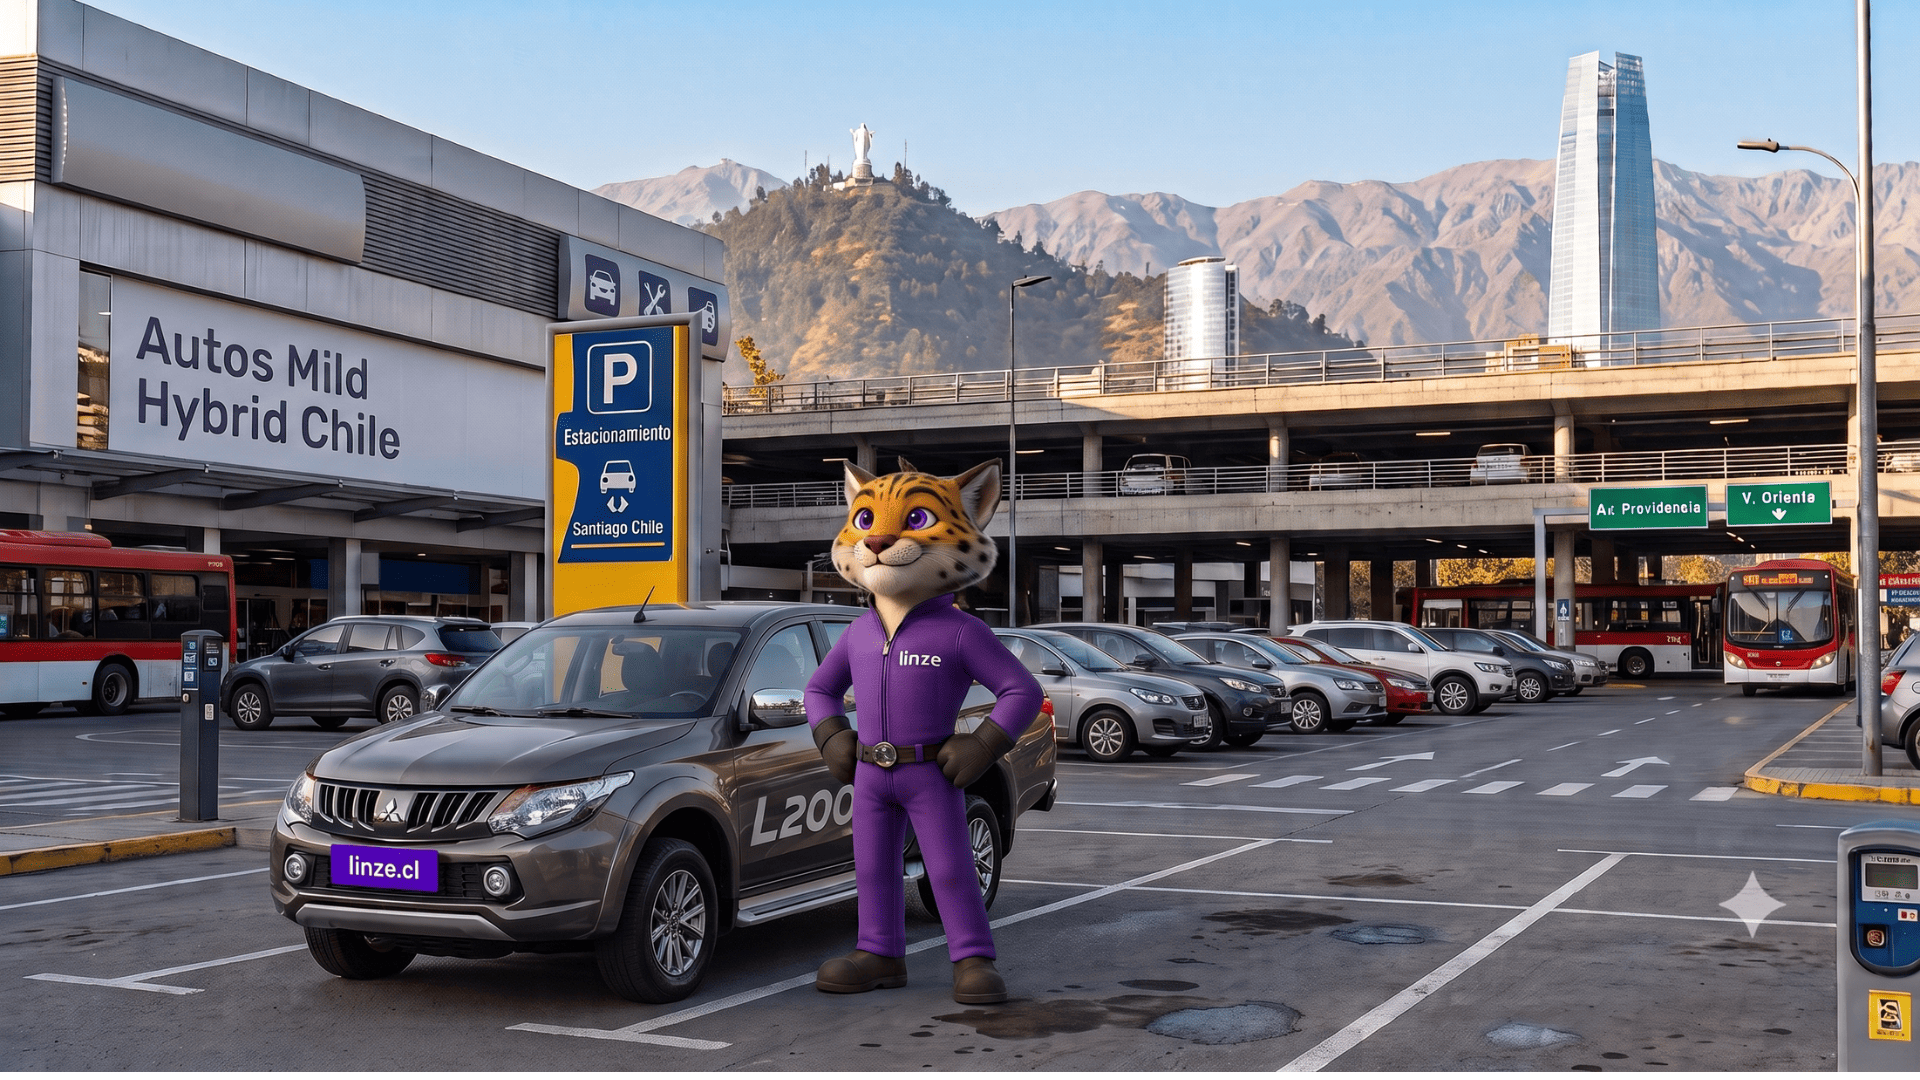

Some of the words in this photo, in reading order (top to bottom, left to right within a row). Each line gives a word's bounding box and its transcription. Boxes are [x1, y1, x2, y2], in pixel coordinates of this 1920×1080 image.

[136, 316, 274, 382] Autos
[288, 344, 368, 400] Mild
[603, 353, 638, 404] P
[138, 377, 287, 441] Hybrid
[302, 405, 400, 460] Chile
[564, 424, 671, 446] Estacionamiento
[1742, 491, 1756, 505] V.
[572, 521, 628, 538] Santiago
[631, 519, 664, 535] Chile
[899, 650, 942, 667] linze
[750, 784, 854, 847] L200
[349, 854, 420, 880] linze.cl
